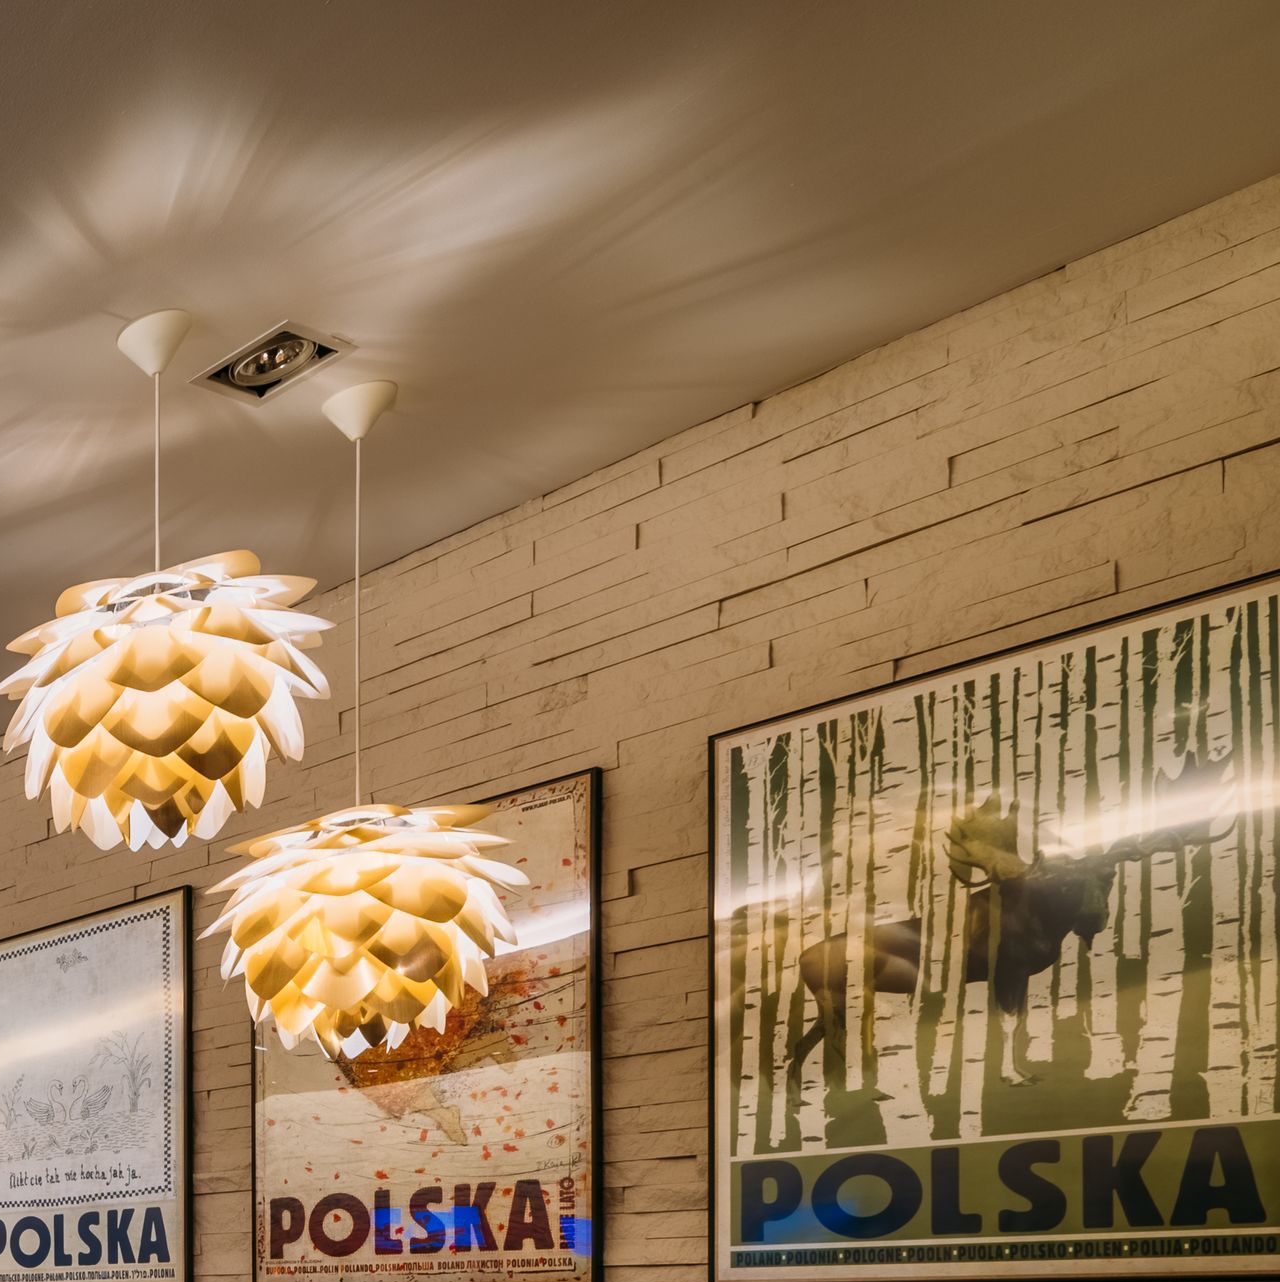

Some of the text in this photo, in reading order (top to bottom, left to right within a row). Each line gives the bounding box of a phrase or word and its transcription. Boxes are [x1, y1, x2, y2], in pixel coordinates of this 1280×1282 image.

[740, 1126, 1268, 1243] POLSKA
[270, 1179, 554, 1259] POLSKA
[507, 1258, 539, 1268] POLONIA
[542, 1257, 573, 1267] POLSKA
[736, 1252, 781, 1267] POLAND
[786, 1250, 839, 1265] POLONIA
[844, 1248, 903, 1264] POLOGNE
[958, 1245, 1004, 1261] PUOLA
[1010, 1243, 1067, 1259] POLSKO
[1074, 1241, 1123, 1257] POLEN
[150, 1268, 176, 1278] POLONIA
